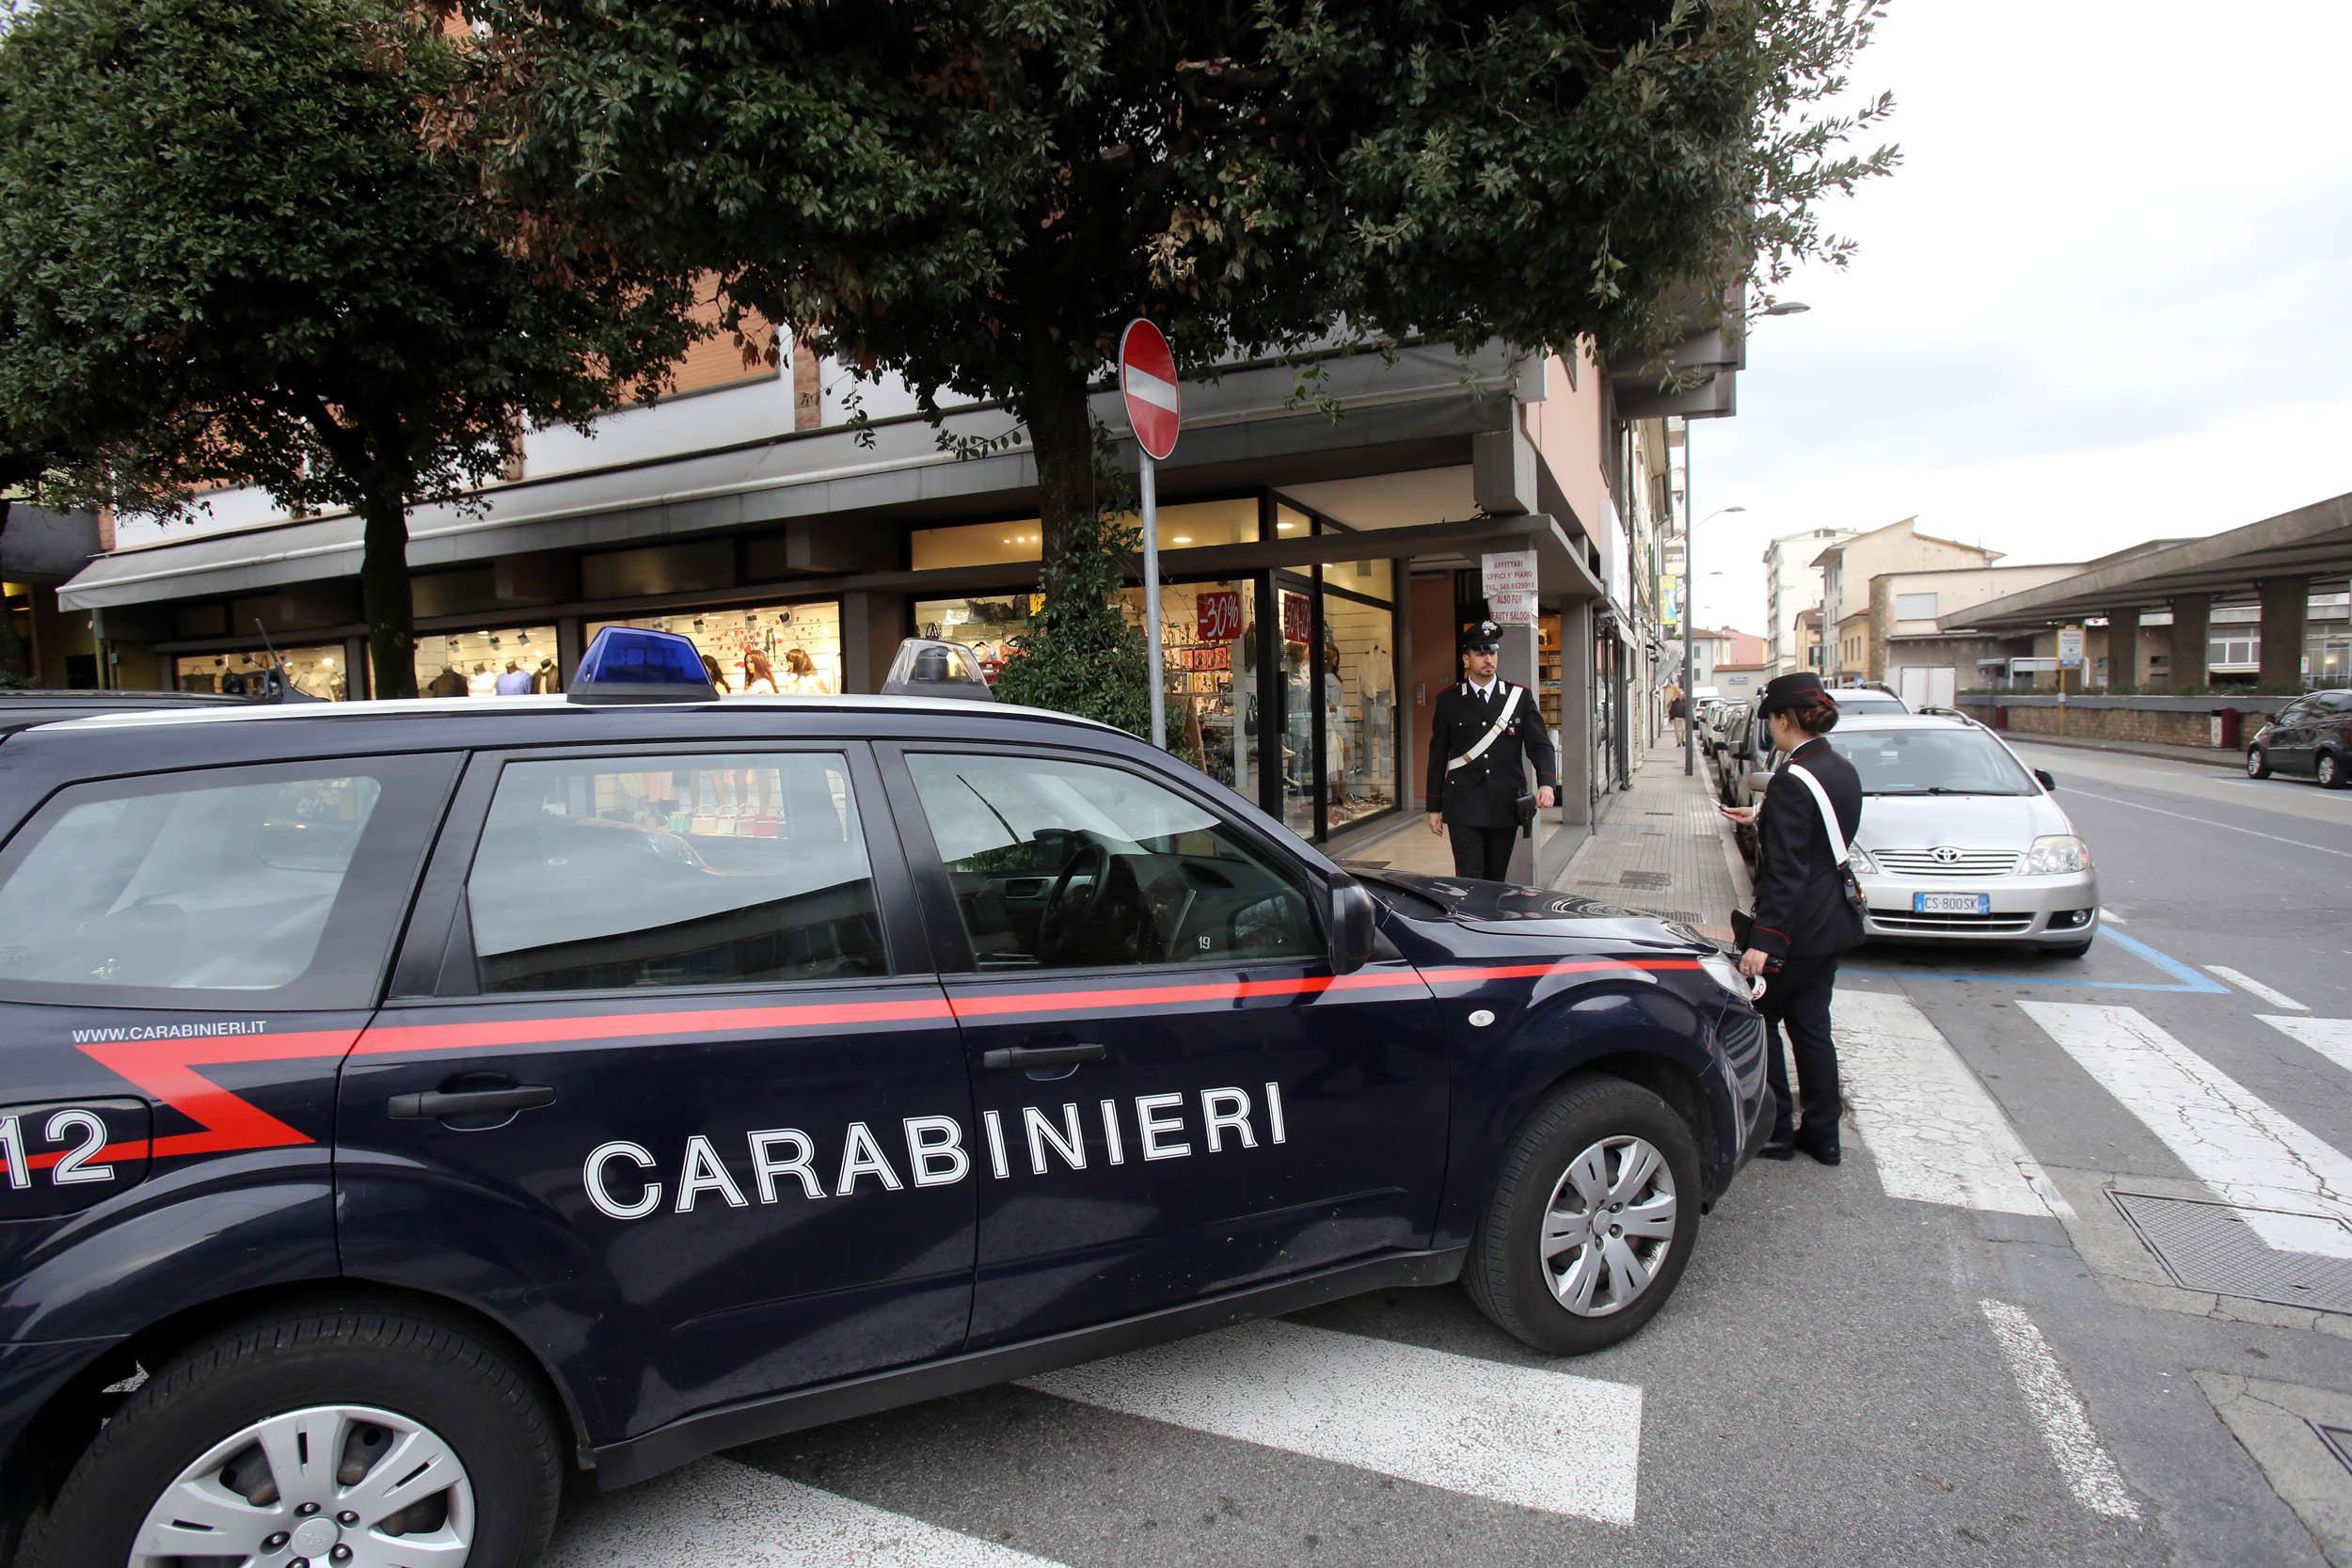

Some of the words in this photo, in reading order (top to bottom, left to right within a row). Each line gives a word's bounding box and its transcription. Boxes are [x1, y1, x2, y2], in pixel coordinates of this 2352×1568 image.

[1486, 572, 1505, 580] UFFICI
[1497, 594, 1511, 604] ALSO
[1200, 594, 1239, 638] -30%
[1199, 936, 1210, 949] 19
[72, 1021, 267, 1043] WWW.CARABINIERI.IT
[583, 1082, 1286, 1219] CARABINIERI
